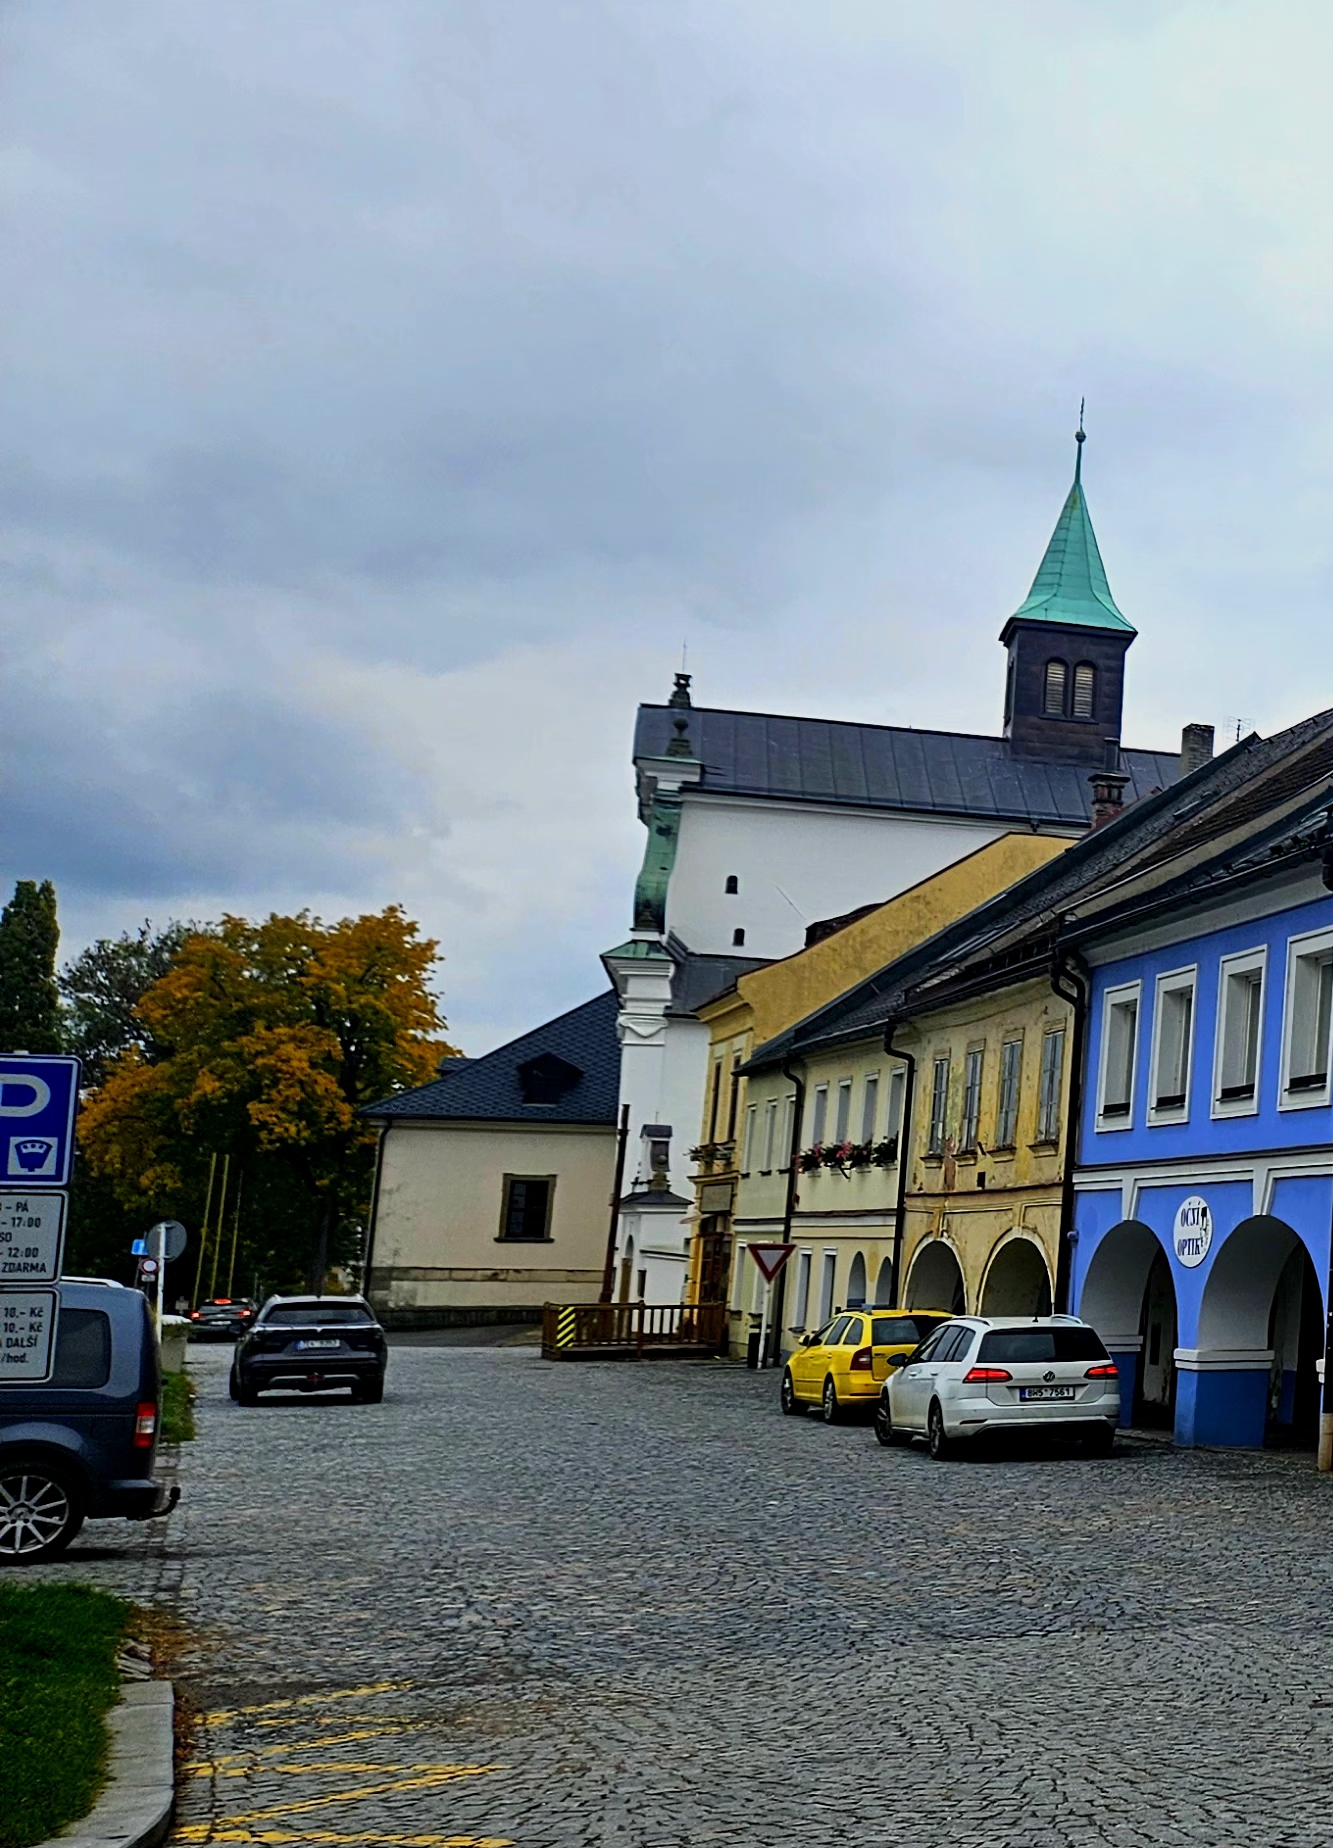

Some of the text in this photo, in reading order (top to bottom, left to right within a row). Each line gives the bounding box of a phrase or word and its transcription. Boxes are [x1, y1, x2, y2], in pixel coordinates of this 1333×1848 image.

[15, 1199, 29, 1213] PÁ
[11, 1216, 41, 1228] 17:00
[8, 1247, 39, 1258] 12:00
[1, 1262, 47, 1273] ZDARMA
[6, 1334, 38, 1348] DALŠÍ
